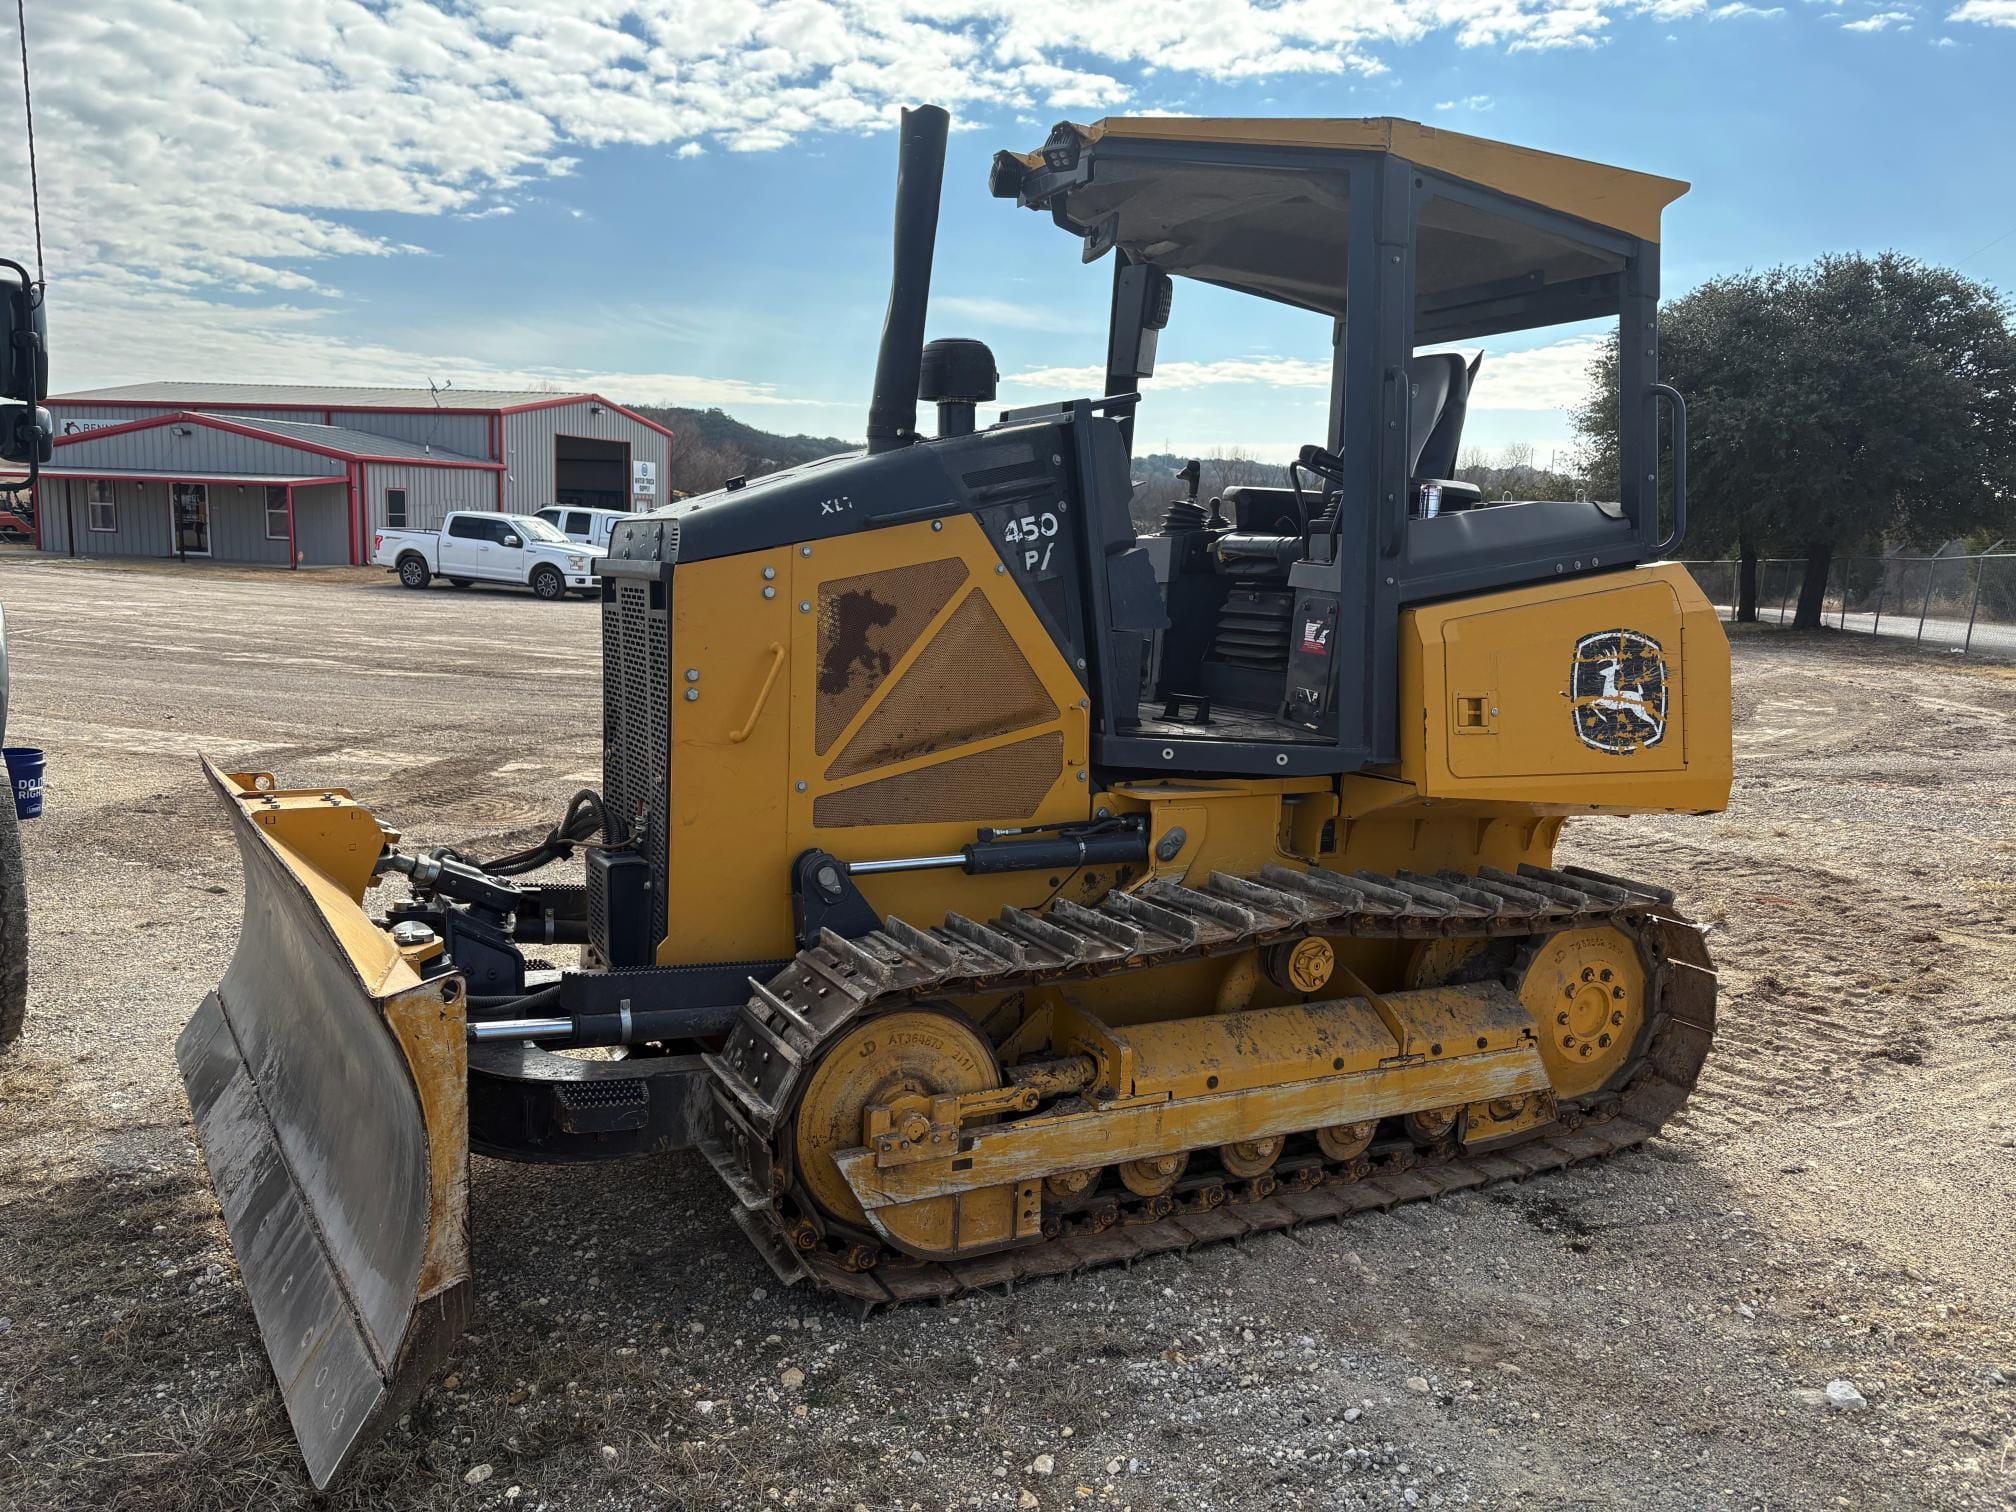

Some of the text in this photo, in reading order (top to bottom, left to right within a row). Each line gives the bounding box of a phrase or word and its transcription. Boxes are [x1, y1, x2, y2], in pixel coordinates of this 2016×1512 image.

[1004, 512, 1058, 543] 450
[18, 778, 36, 790] DO
[18, 789, 43, 800] RIGH
